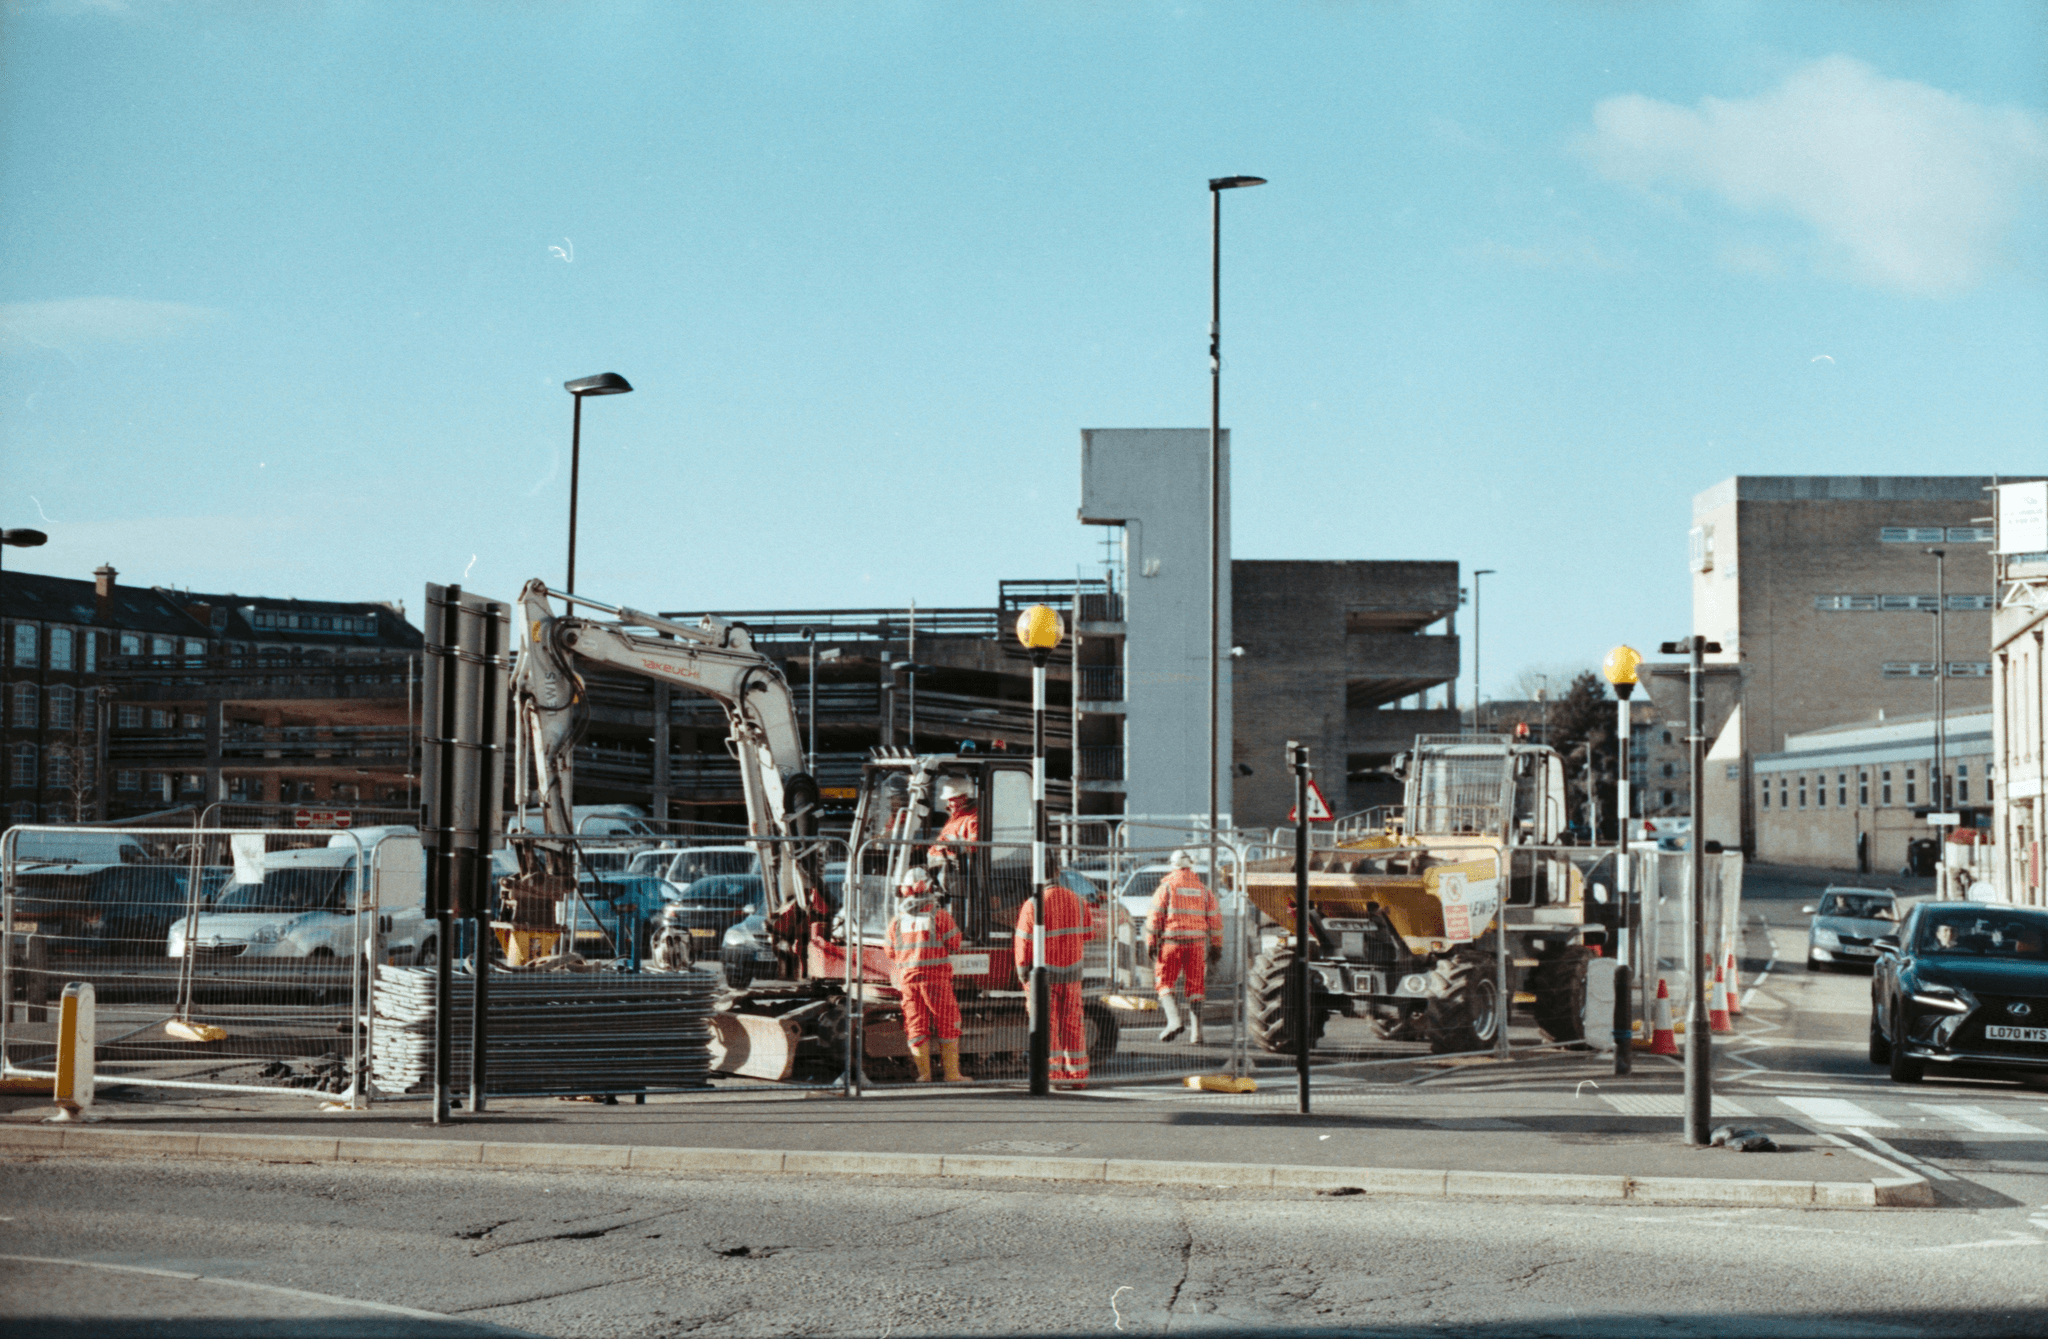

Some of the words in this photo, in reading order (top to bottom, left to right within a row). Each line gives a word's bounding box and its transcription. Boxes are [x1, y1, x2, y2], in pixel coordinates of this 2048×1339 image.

[545, 672, 557, 716] LEWIS
[1990, 1027, 2021, 1039] LO70
[2023, 1028, 2047, 1040] WYS
